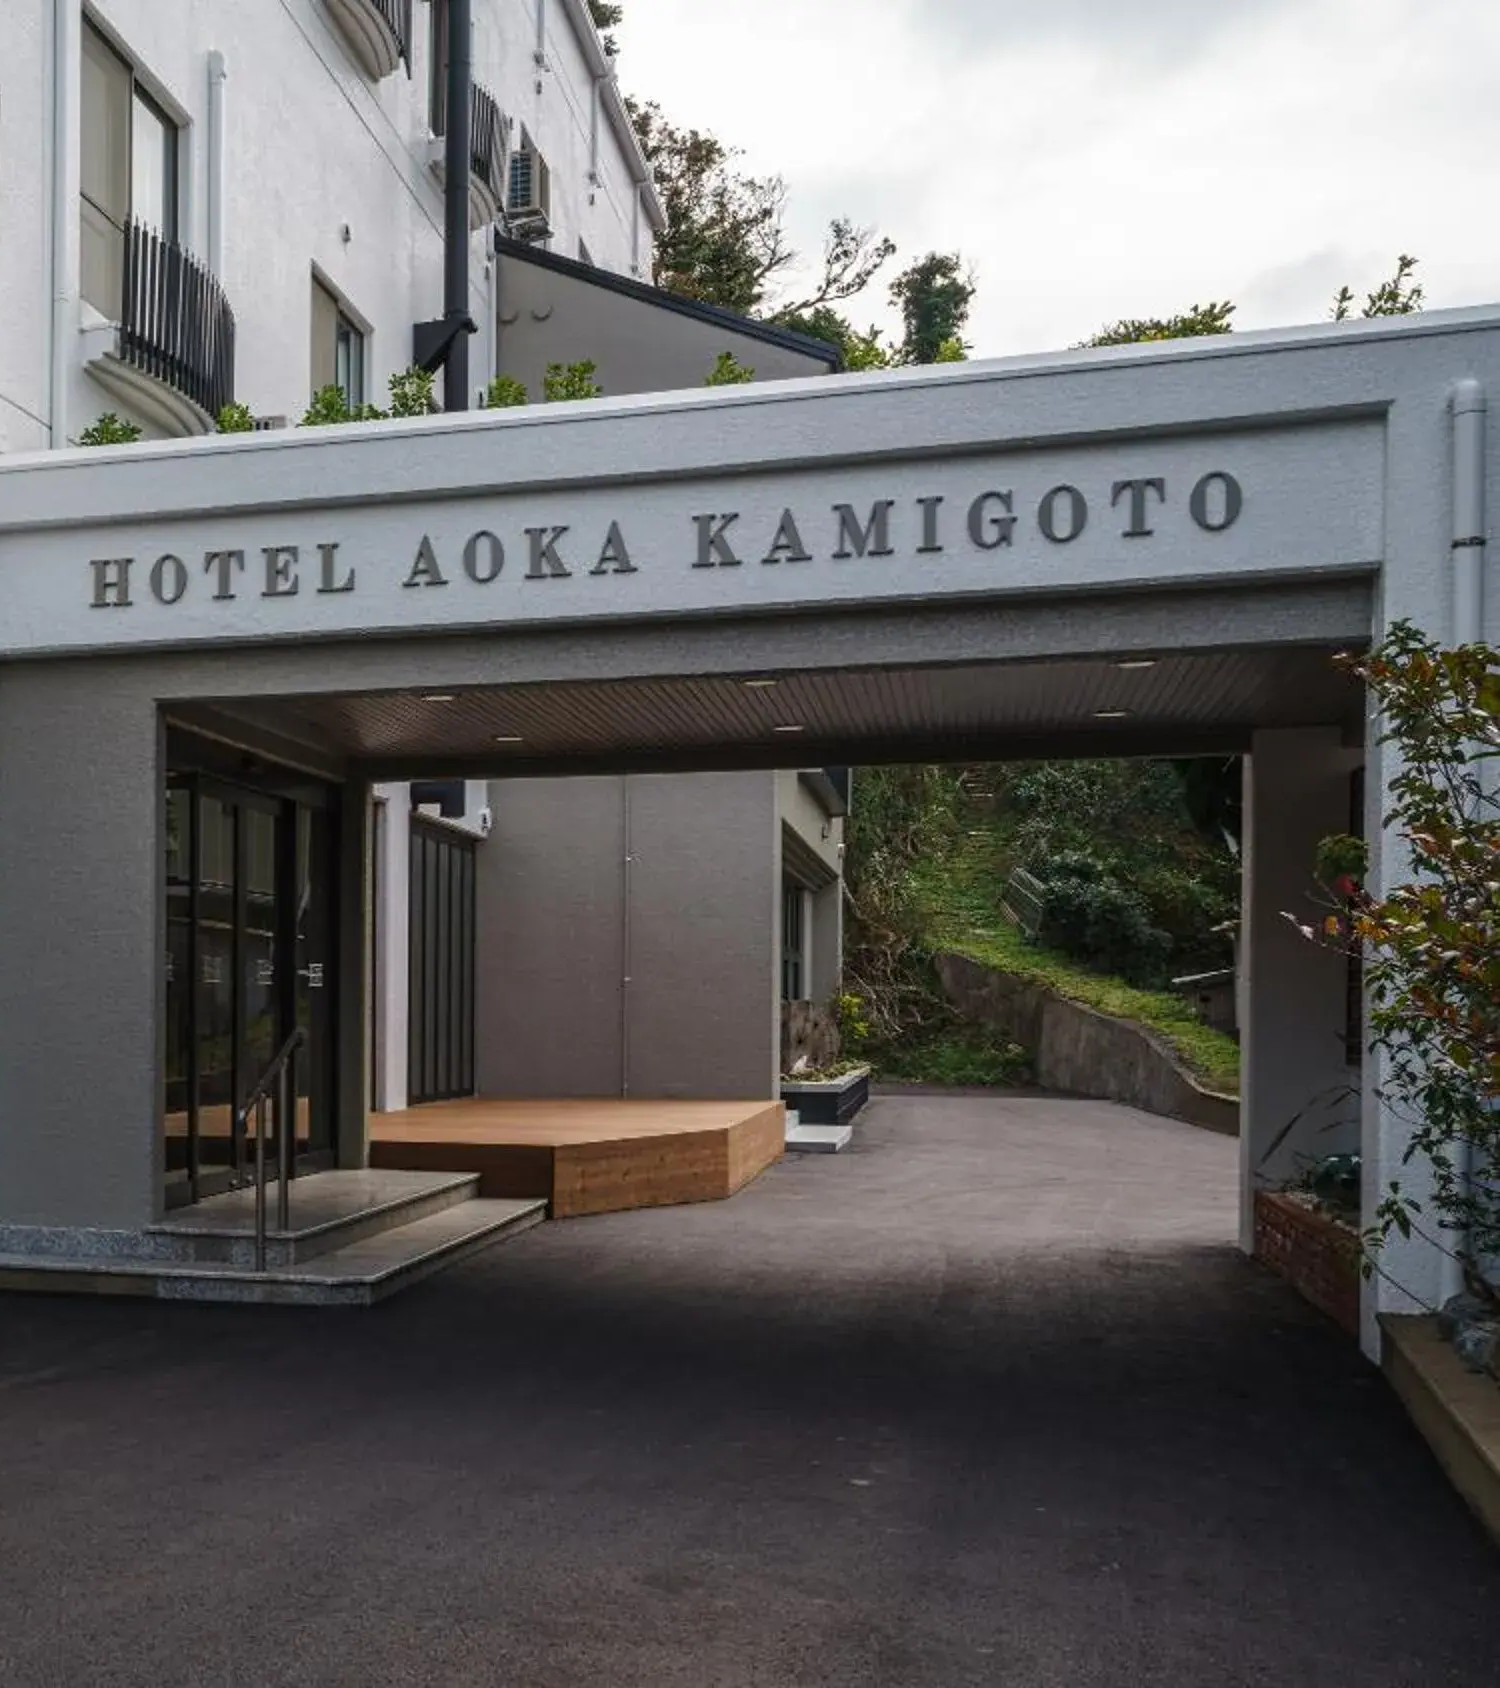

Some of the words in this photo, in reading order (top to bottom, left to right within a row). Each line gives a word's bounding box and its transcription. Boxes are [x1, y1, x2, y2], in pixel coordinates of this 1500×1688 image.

[89, 542, 356, 609] HOTEL
[402, 520, 639, 589] AOKA
[691, 470, 1244, 570] KAMIGOTO
